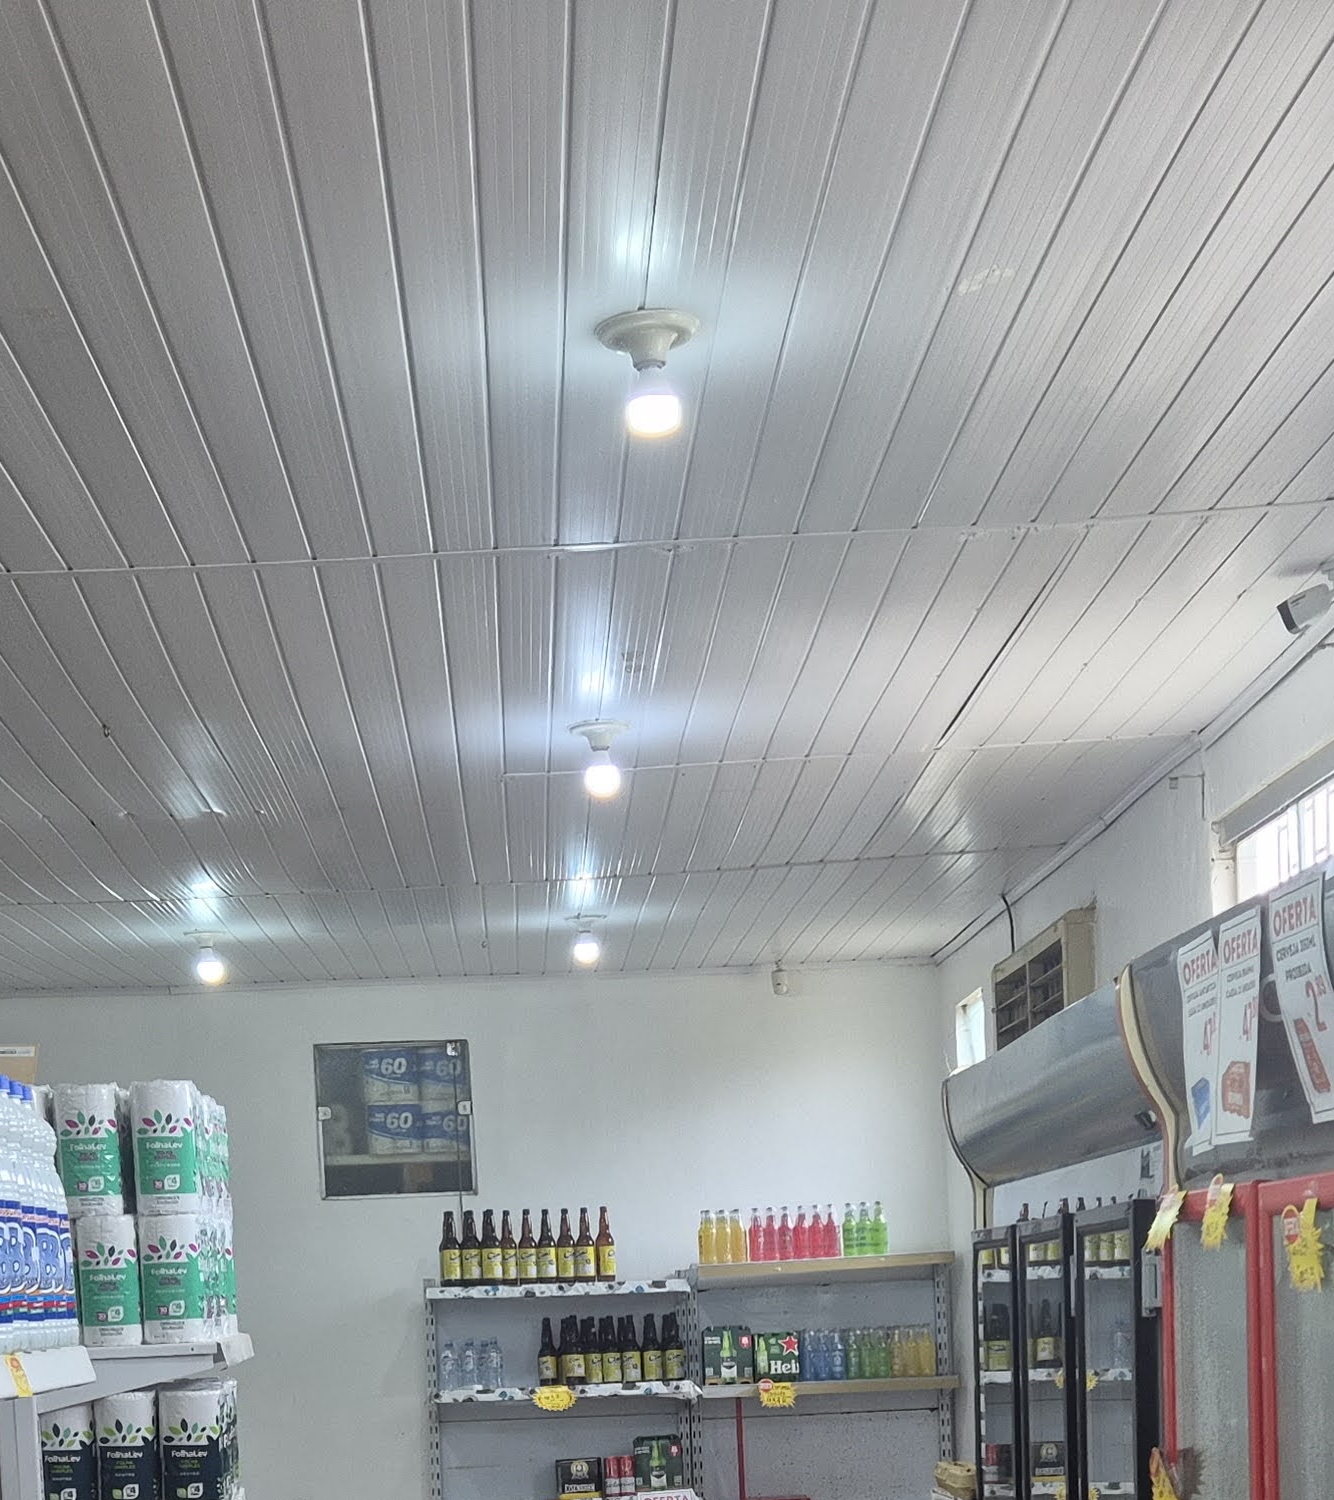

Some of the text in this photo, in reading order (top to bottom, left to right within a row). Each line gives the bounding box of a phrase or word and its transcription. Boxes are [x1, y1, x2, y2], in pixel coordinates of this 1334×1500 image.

[1273, 895, 1317, 937] OFERTA
[1223, 927, 1259, 965] OFERTA
[1182, 949, 1218, 986] OFERTA
